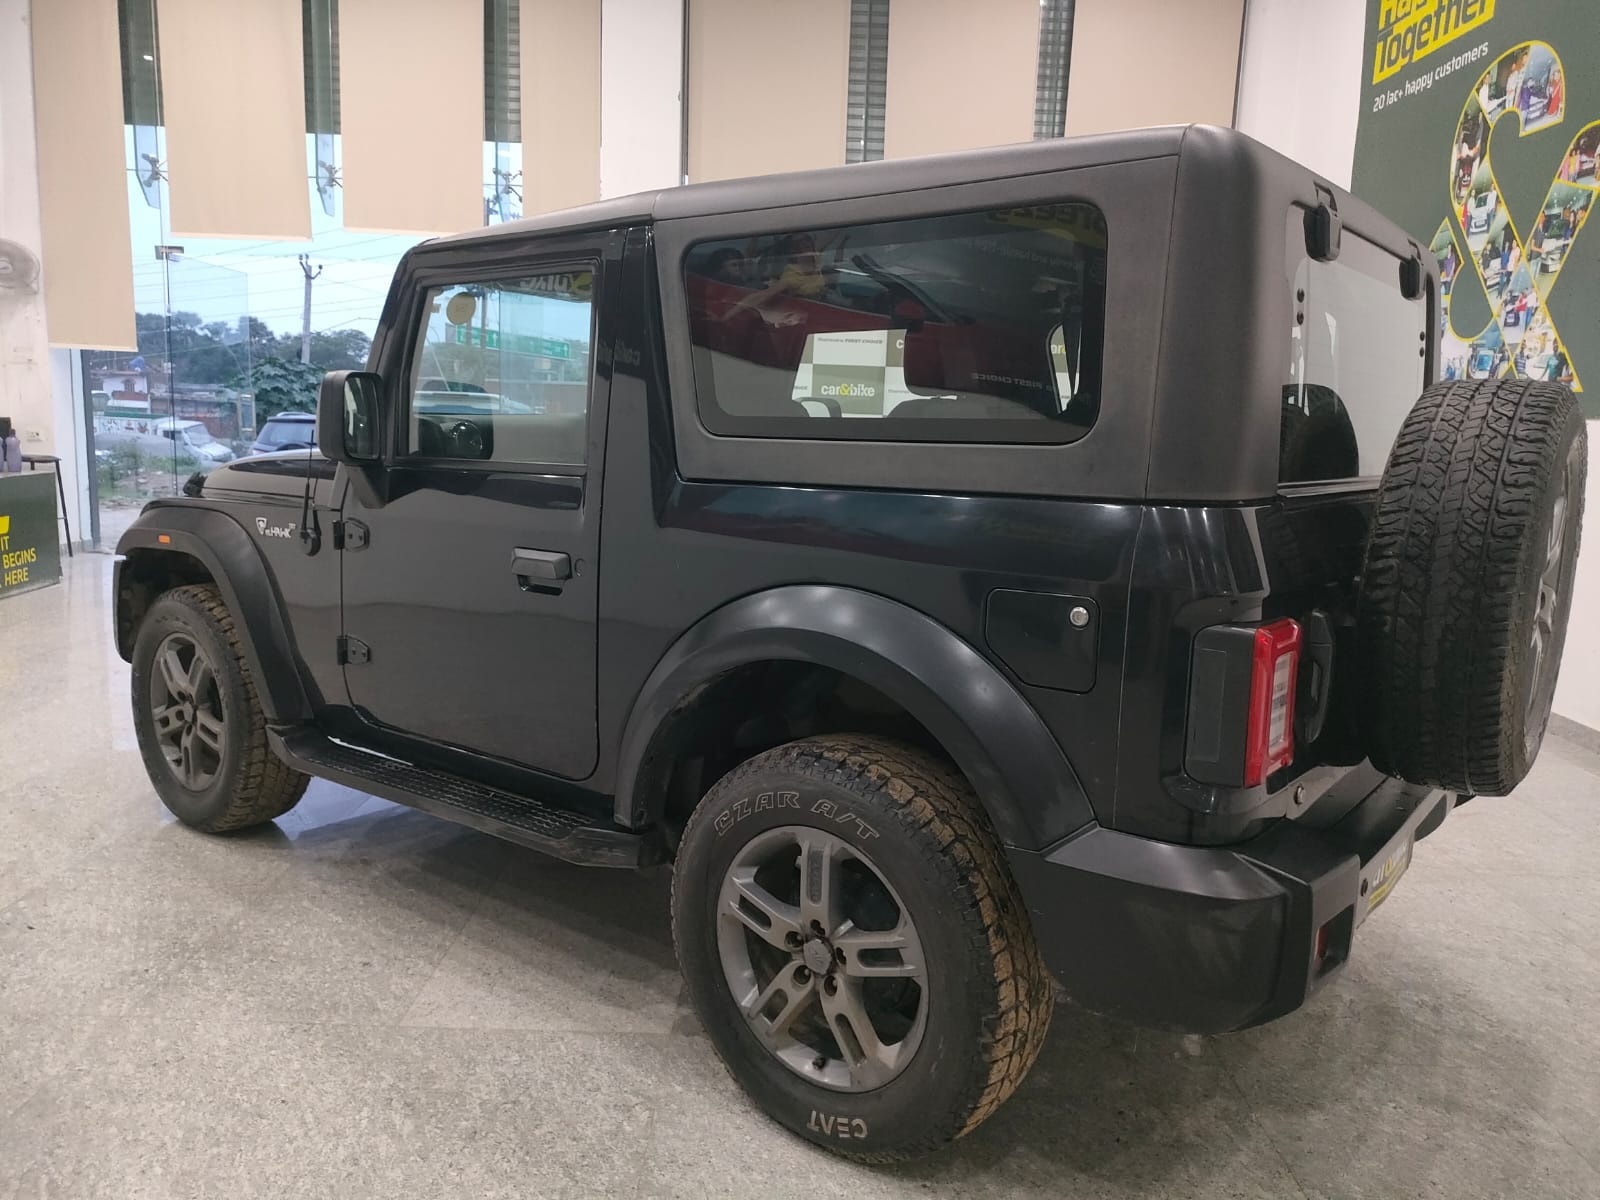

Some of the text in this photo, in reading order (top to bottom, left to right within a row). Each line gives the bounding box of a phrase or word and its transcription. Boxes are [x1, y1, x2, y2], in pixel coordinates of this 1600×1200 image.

[1378, 0, 1487, 72] Together
[1373, 94, 1385, 113] 20
[1404, 71, 1434, 97] happy
[1434, 41, 1489, 81] customers
[821, 383, 876, 397] car&bike
[0, 535, 10, 551] IT
[2, 547, 37, 569] BEGINS
[4, 567, 29, 586] HERE
[713, 791, 880, 841] CZAR A/T
[806, 1110, 868, 1138] CEAT
